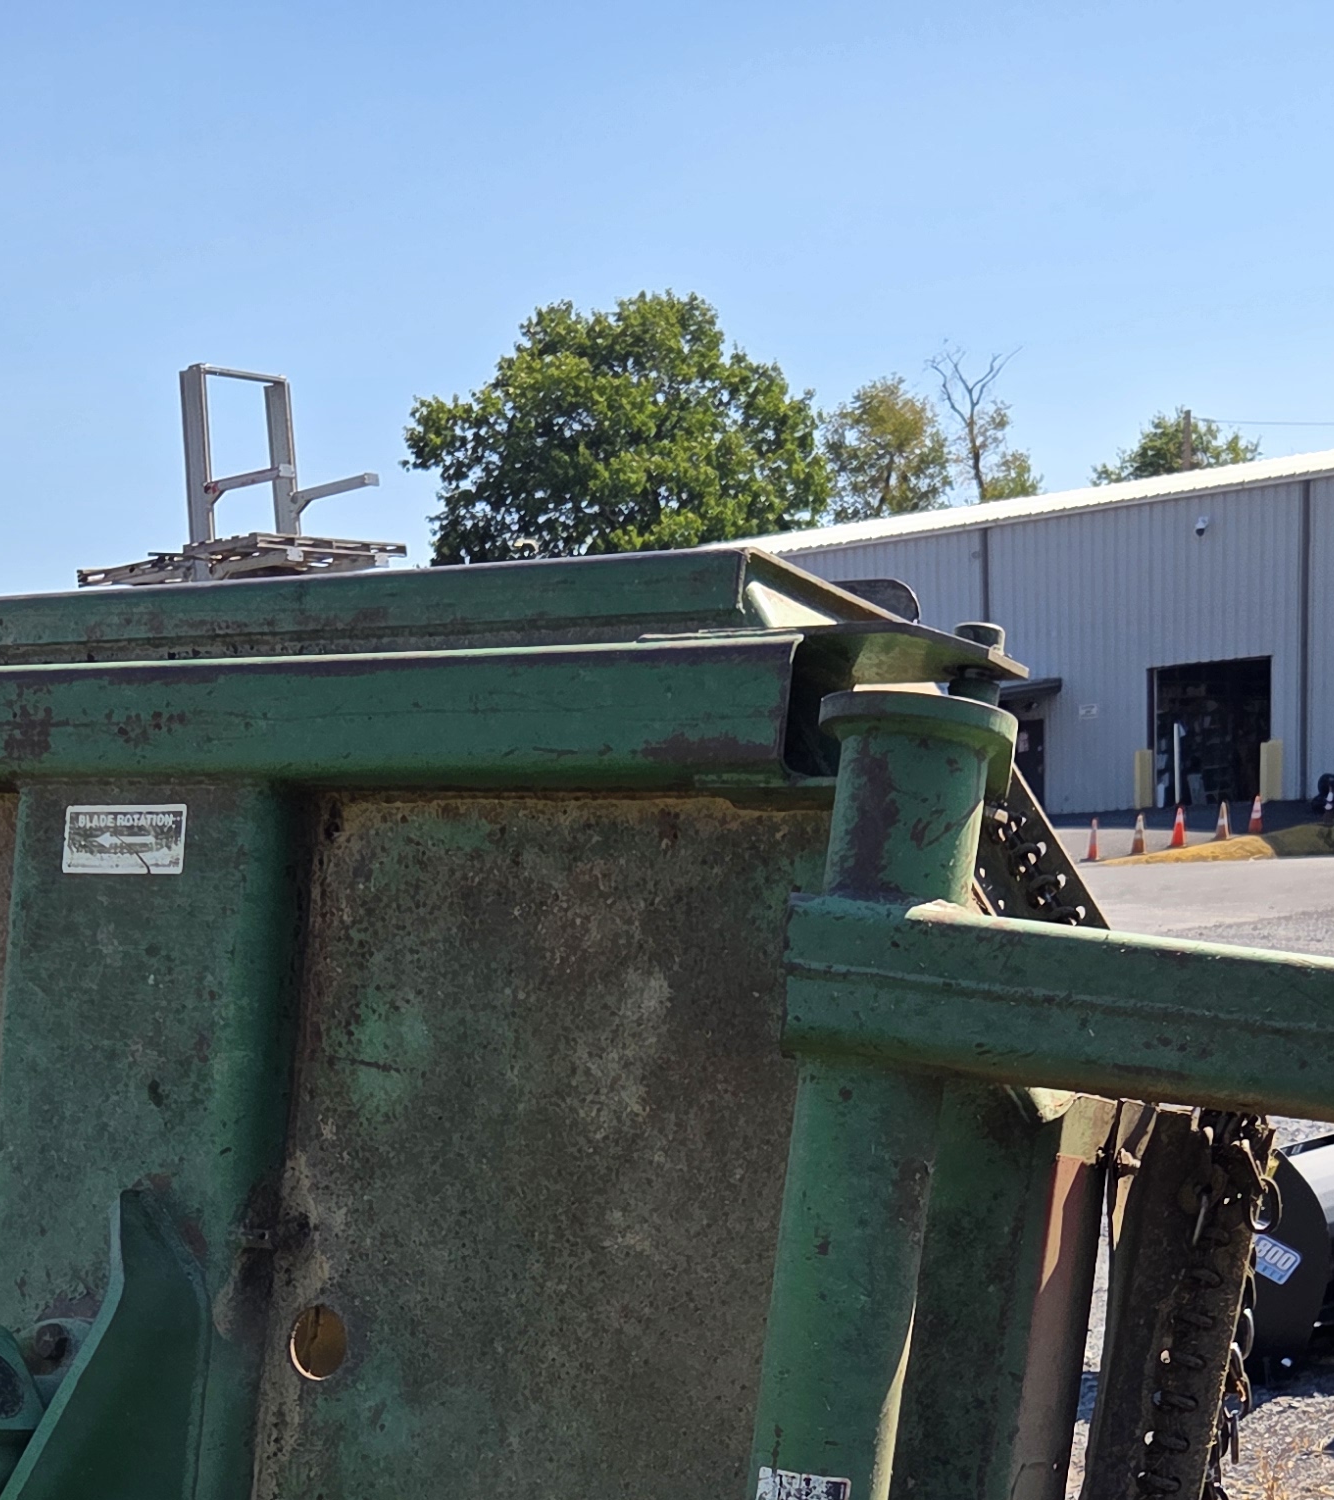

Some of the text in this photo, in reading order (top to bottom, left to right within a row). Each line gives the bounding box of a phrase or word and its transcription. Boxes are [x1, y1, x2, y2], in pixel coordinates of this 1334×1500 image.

[78, 814, 173, 827] BLADE ROTATION
[1255, 1238, 1295, 1272] 800
